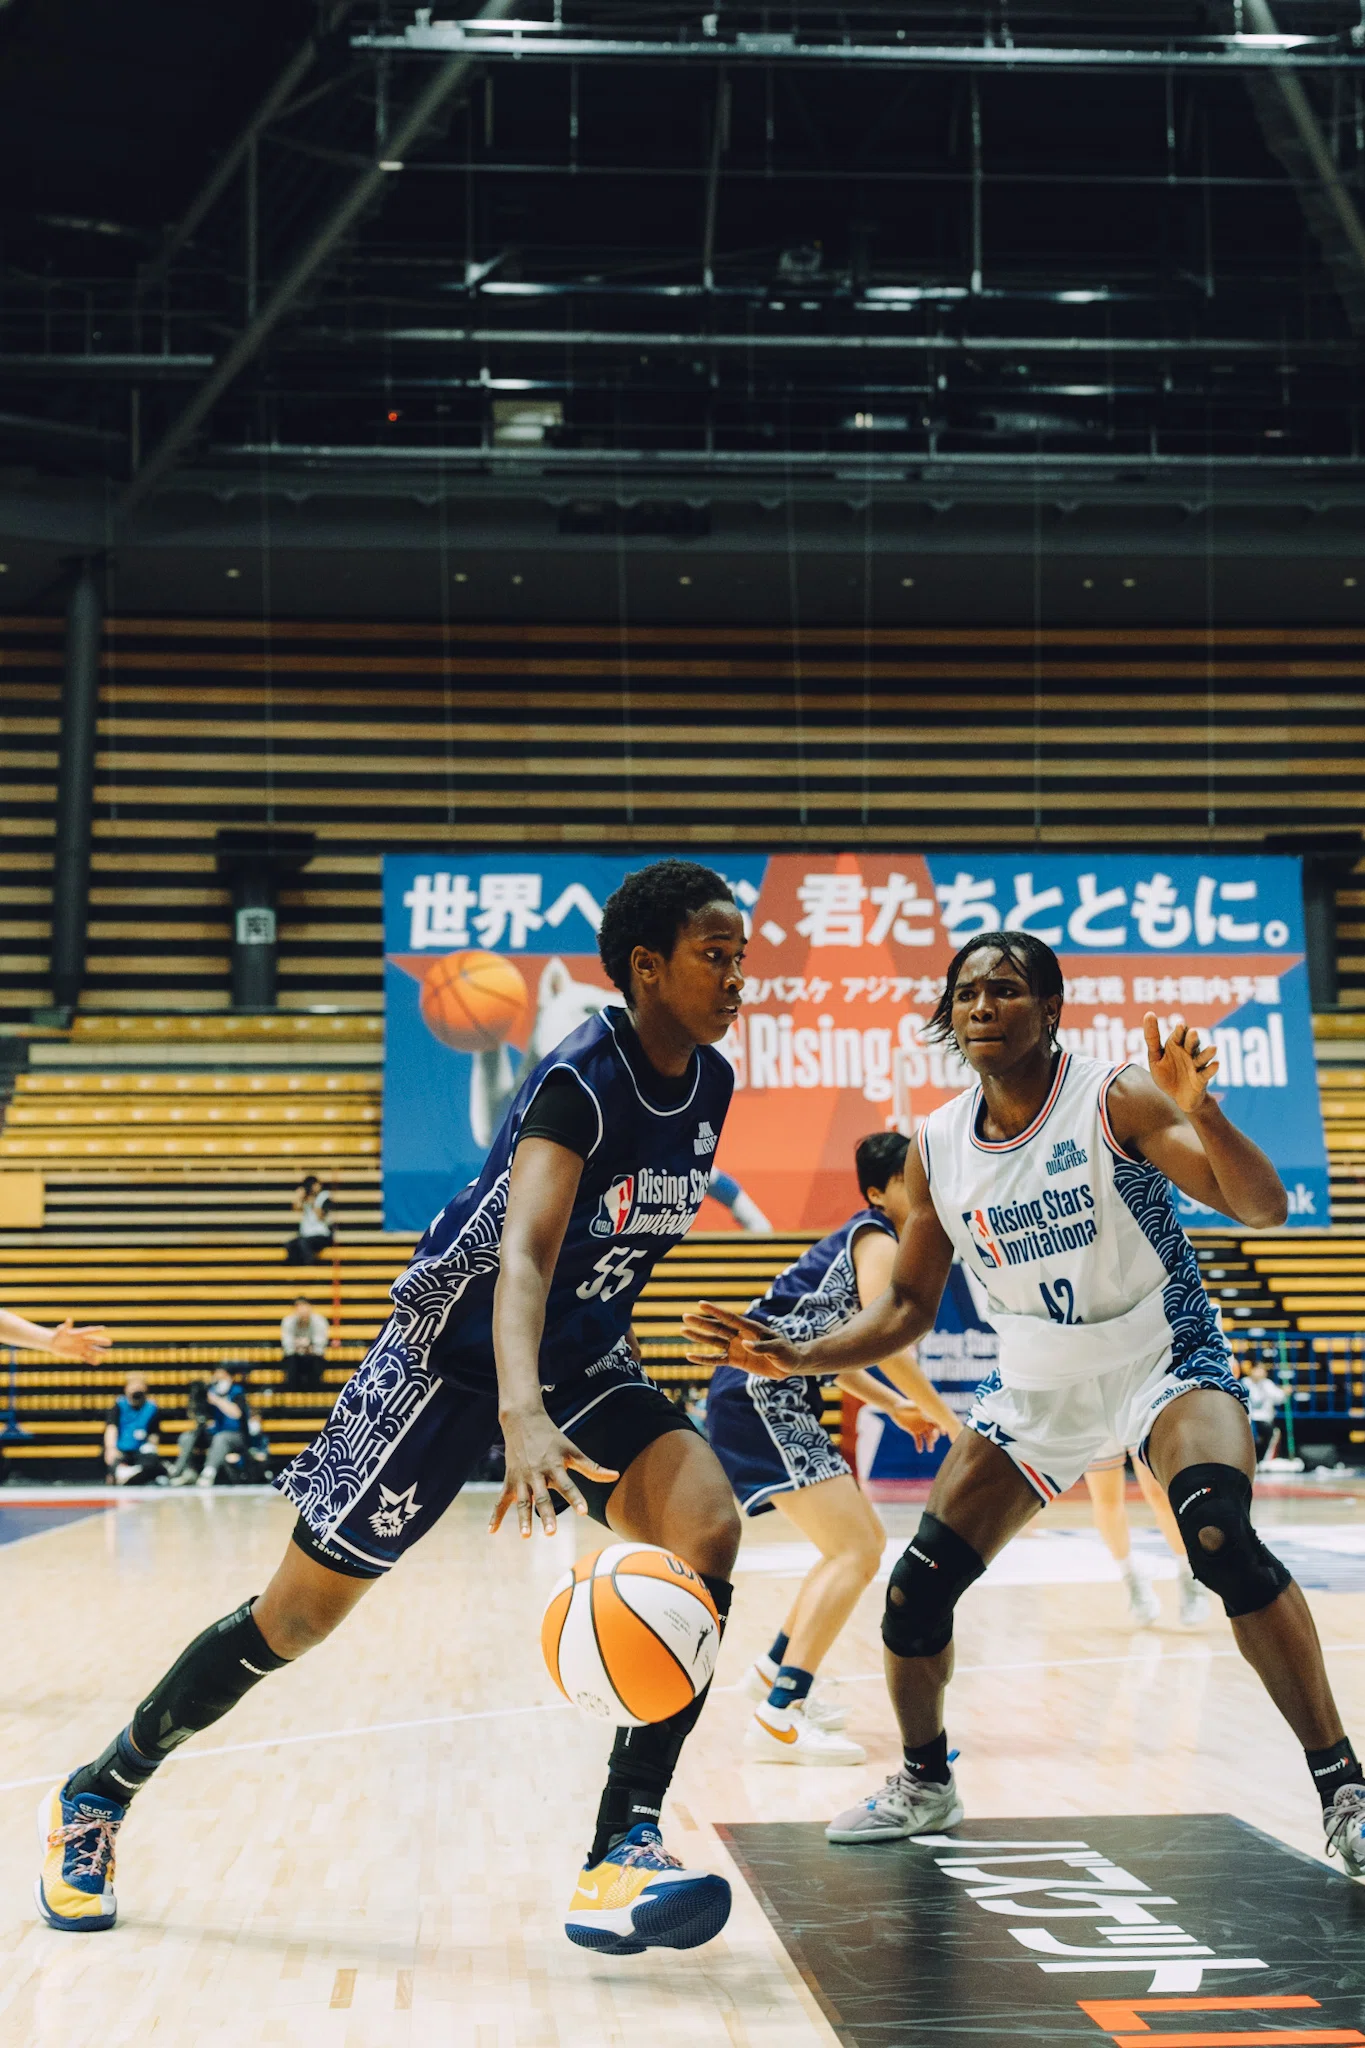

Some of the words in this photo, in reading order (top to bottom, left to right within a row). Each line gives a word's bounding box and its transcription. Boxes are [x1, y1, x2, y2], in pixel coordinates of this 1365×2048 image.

[749, 1013, 892, 1101] Rising
[898, 1012, 980, 1089] Sta
[1046, 1149, 1088, 1176] QUALIFIERS
[1052, 1139, 1077, 1159] JAPAN
[637, 1167, 689, 1211] Rising
[987, 1200, 1047, 1236] Rising
[1042, 1184, 1094, 1220] Stars
[594, 1219, 612, 1234] NBA
[998, 1212, 1098, 1266] Invitationa
[576, 1245, 648, 1302] 55
[1039, 1278, 1084, 1325] 42
[908, 1835, 1270, 1993] バスケット
[1076, 1994, 1365, 2048] LI
